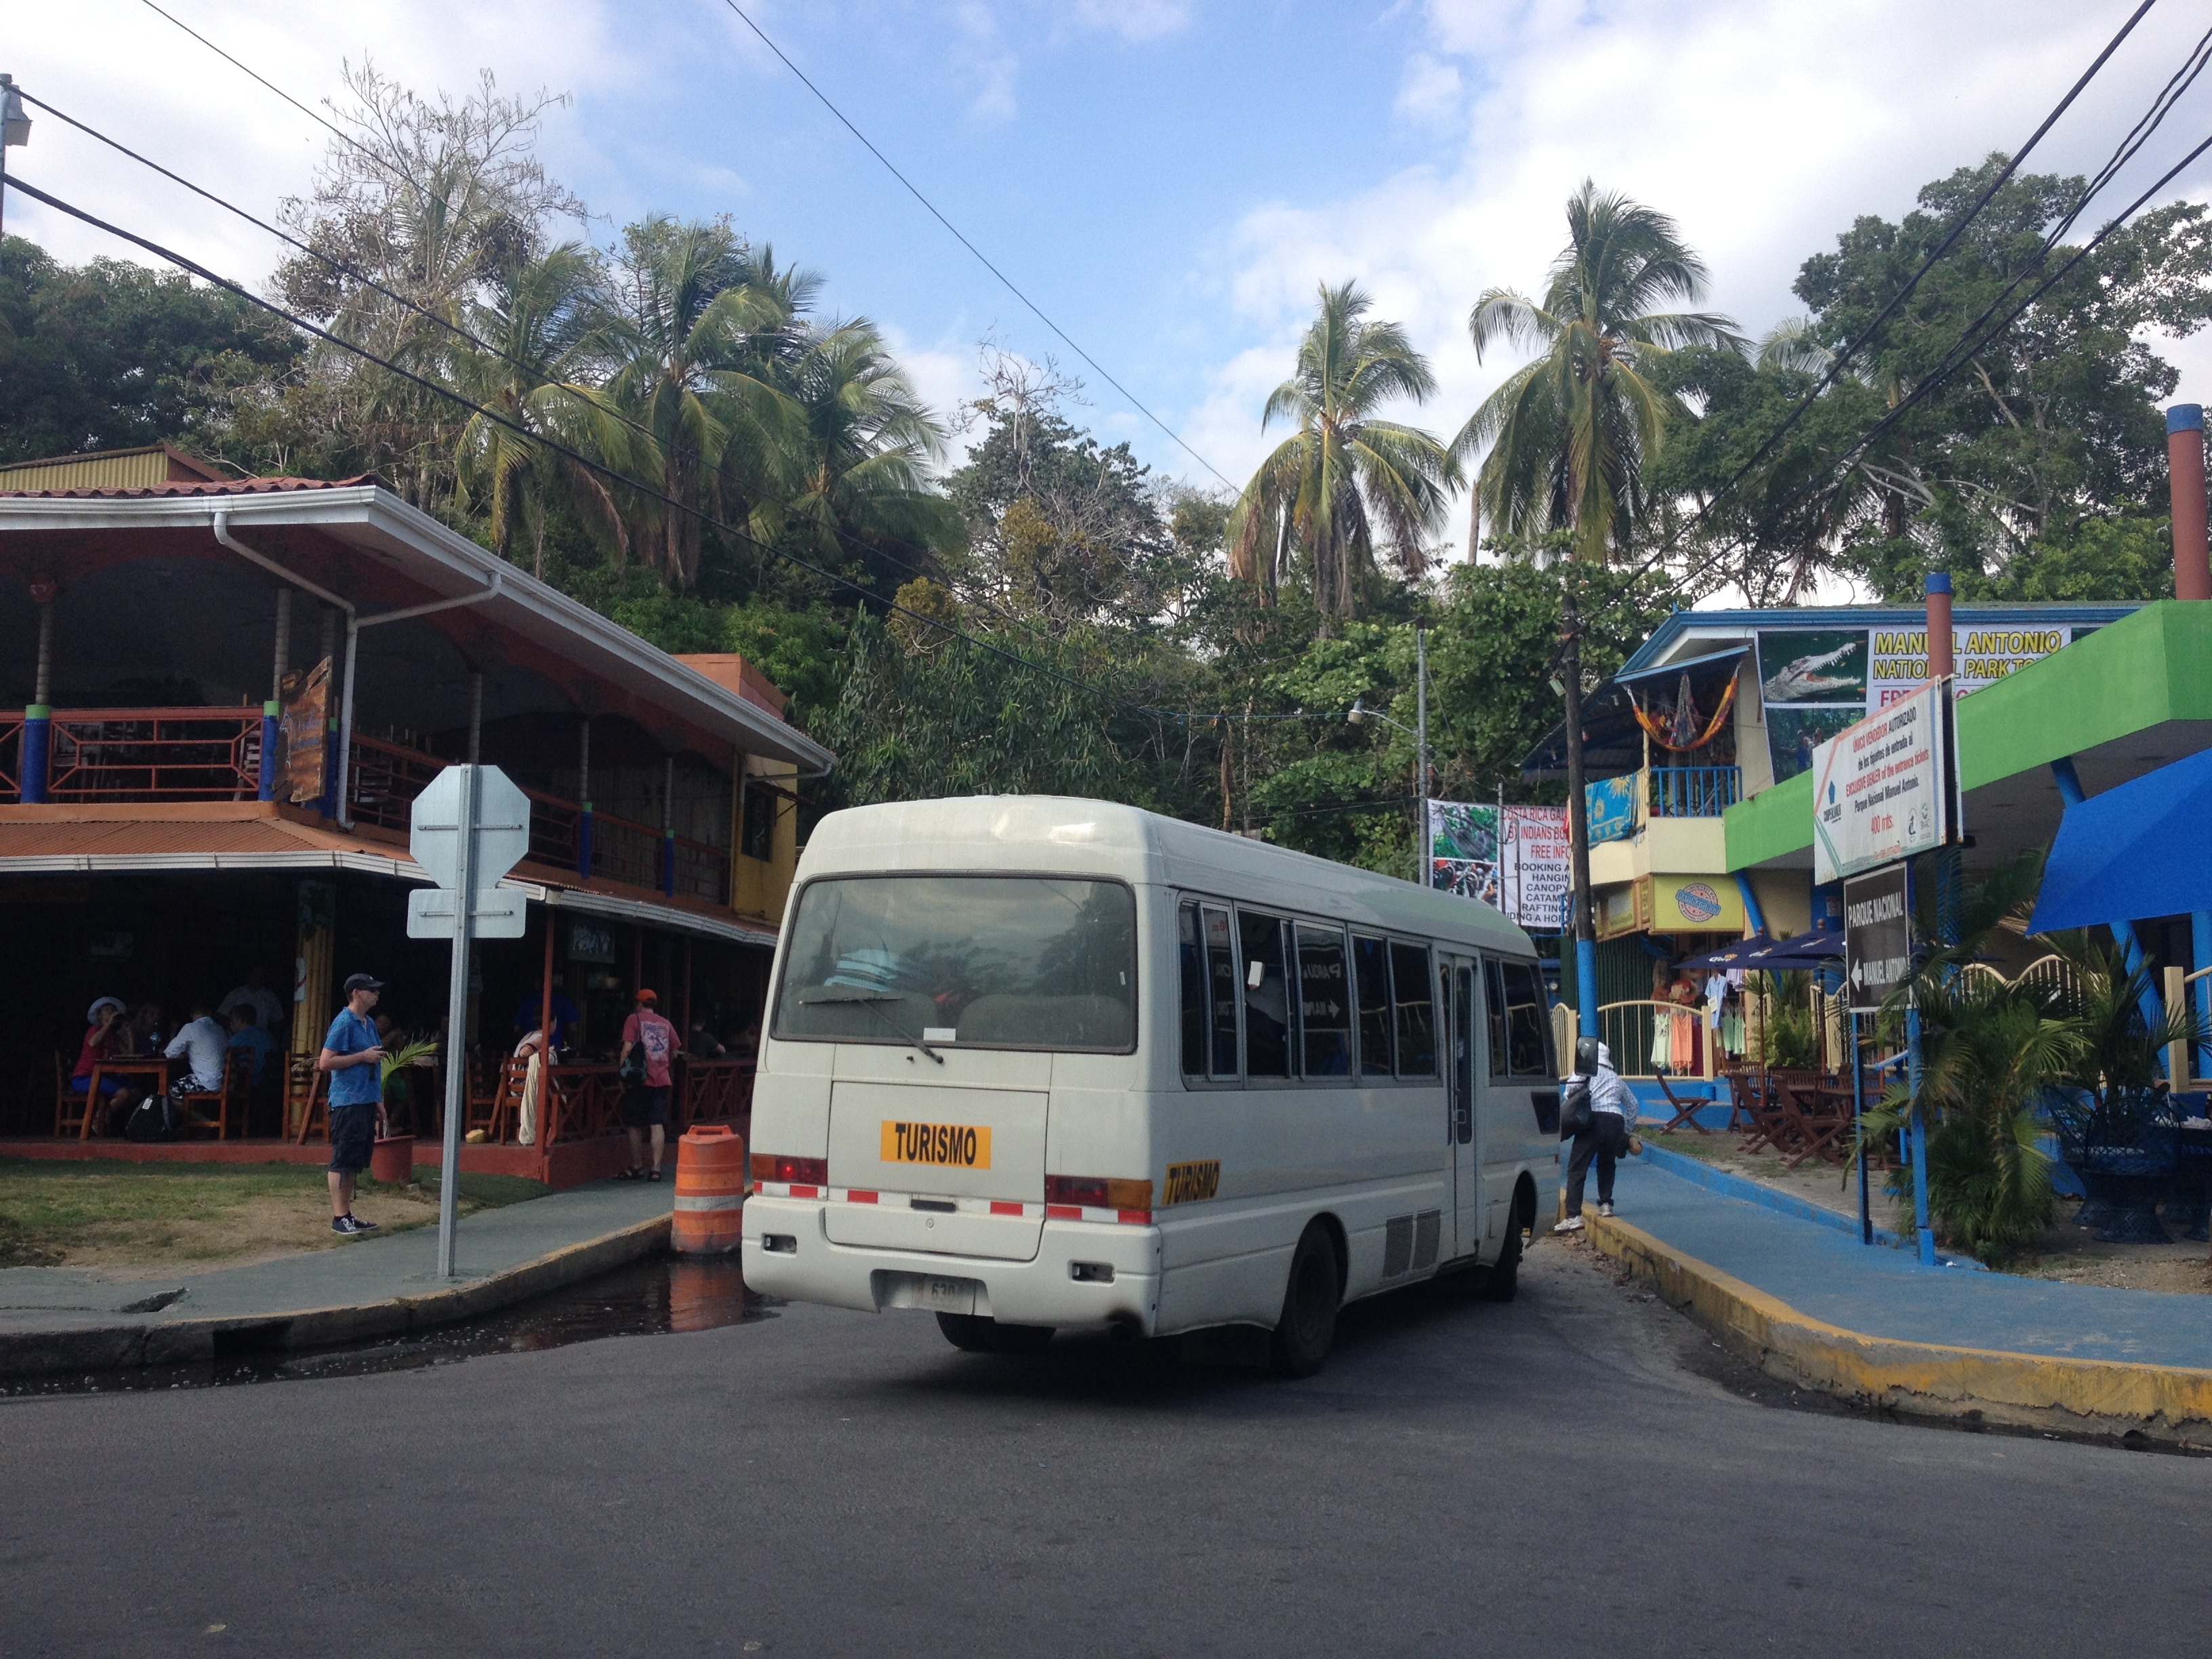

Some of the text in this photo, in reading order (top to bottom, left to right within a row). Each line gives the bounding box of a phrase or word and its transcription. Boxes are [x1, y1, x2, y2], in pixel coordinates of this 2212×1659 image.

[1875, 631, 2062, 655] MANL ANTONIO
[1873, 659, 1961, 679] NATIOL
[1964, 658, 2011, 678] PARK
[1888, 706, 1917, 734] AUTORIZADO
[1866, 768, 1881, 787] DEALER
[1854, 799, 1868, 814] Parque
[1868, 787, 1884, 807] Nacional
[1885, 780, 1901, 800] Manuel
[1530, 807, 1548, 821] RICA
[1521, 825, 1552, 840] INDIANS
[1871, 815, 1881, 835] 400
[1531, 844, 1551, 859] FREE
[1515, 863, 1561, 872] BOOKING
[1532, 874, 1570, 882] HANGIN
[1534, 914, 1542, 922] A
[1847, 892, 1904, 928] PARQUE NACIONAL
[1864, 960, 1885, 986] MANUEL
[895, 1122, 977, 1165] TURISMO
[1167, 1162, 1219, 1206] TURISMO
